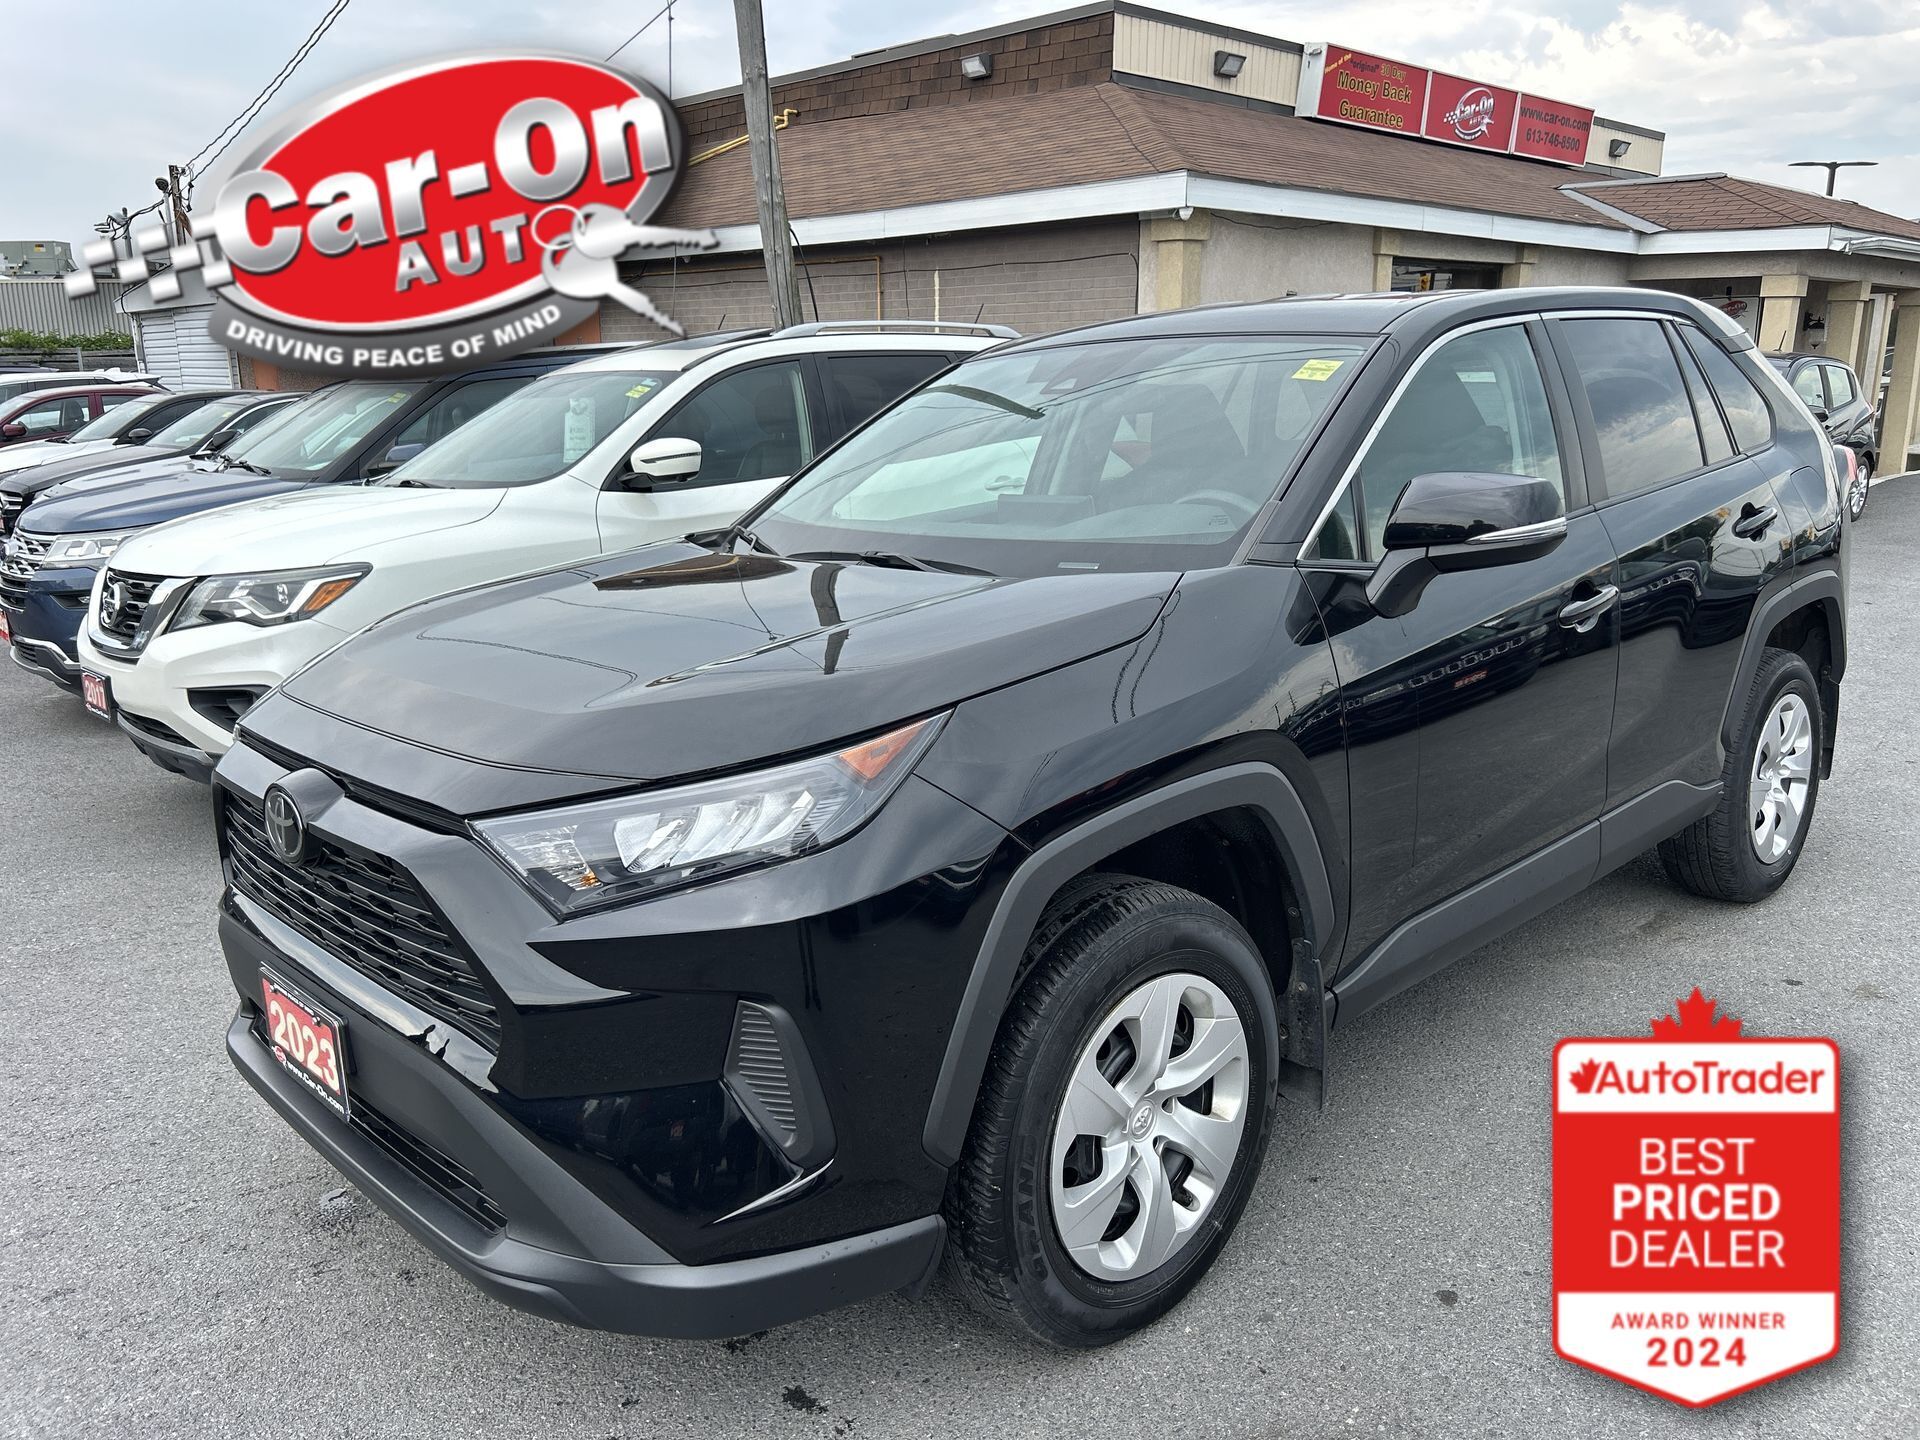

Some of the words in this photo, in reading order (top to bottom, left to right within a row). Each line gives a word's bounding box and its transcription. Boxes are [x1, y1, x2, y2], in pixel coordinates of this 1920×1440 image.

[1337, 69, 1380, 100] Money
[1381, 80, 1413, 104] Back
[1380, 63, 1392, 77] 30
[1391, 66, 1407, 84] Day
[1338, 98, 1404, 129] Guarantee
[1455, 96, 1495, 121] Car-On
[1519, 106, 1591, 133] www.car-on.com
[1525, 127, 1581, 152] 613-746-8500
[269, 1000, 341, 1092] 2023
